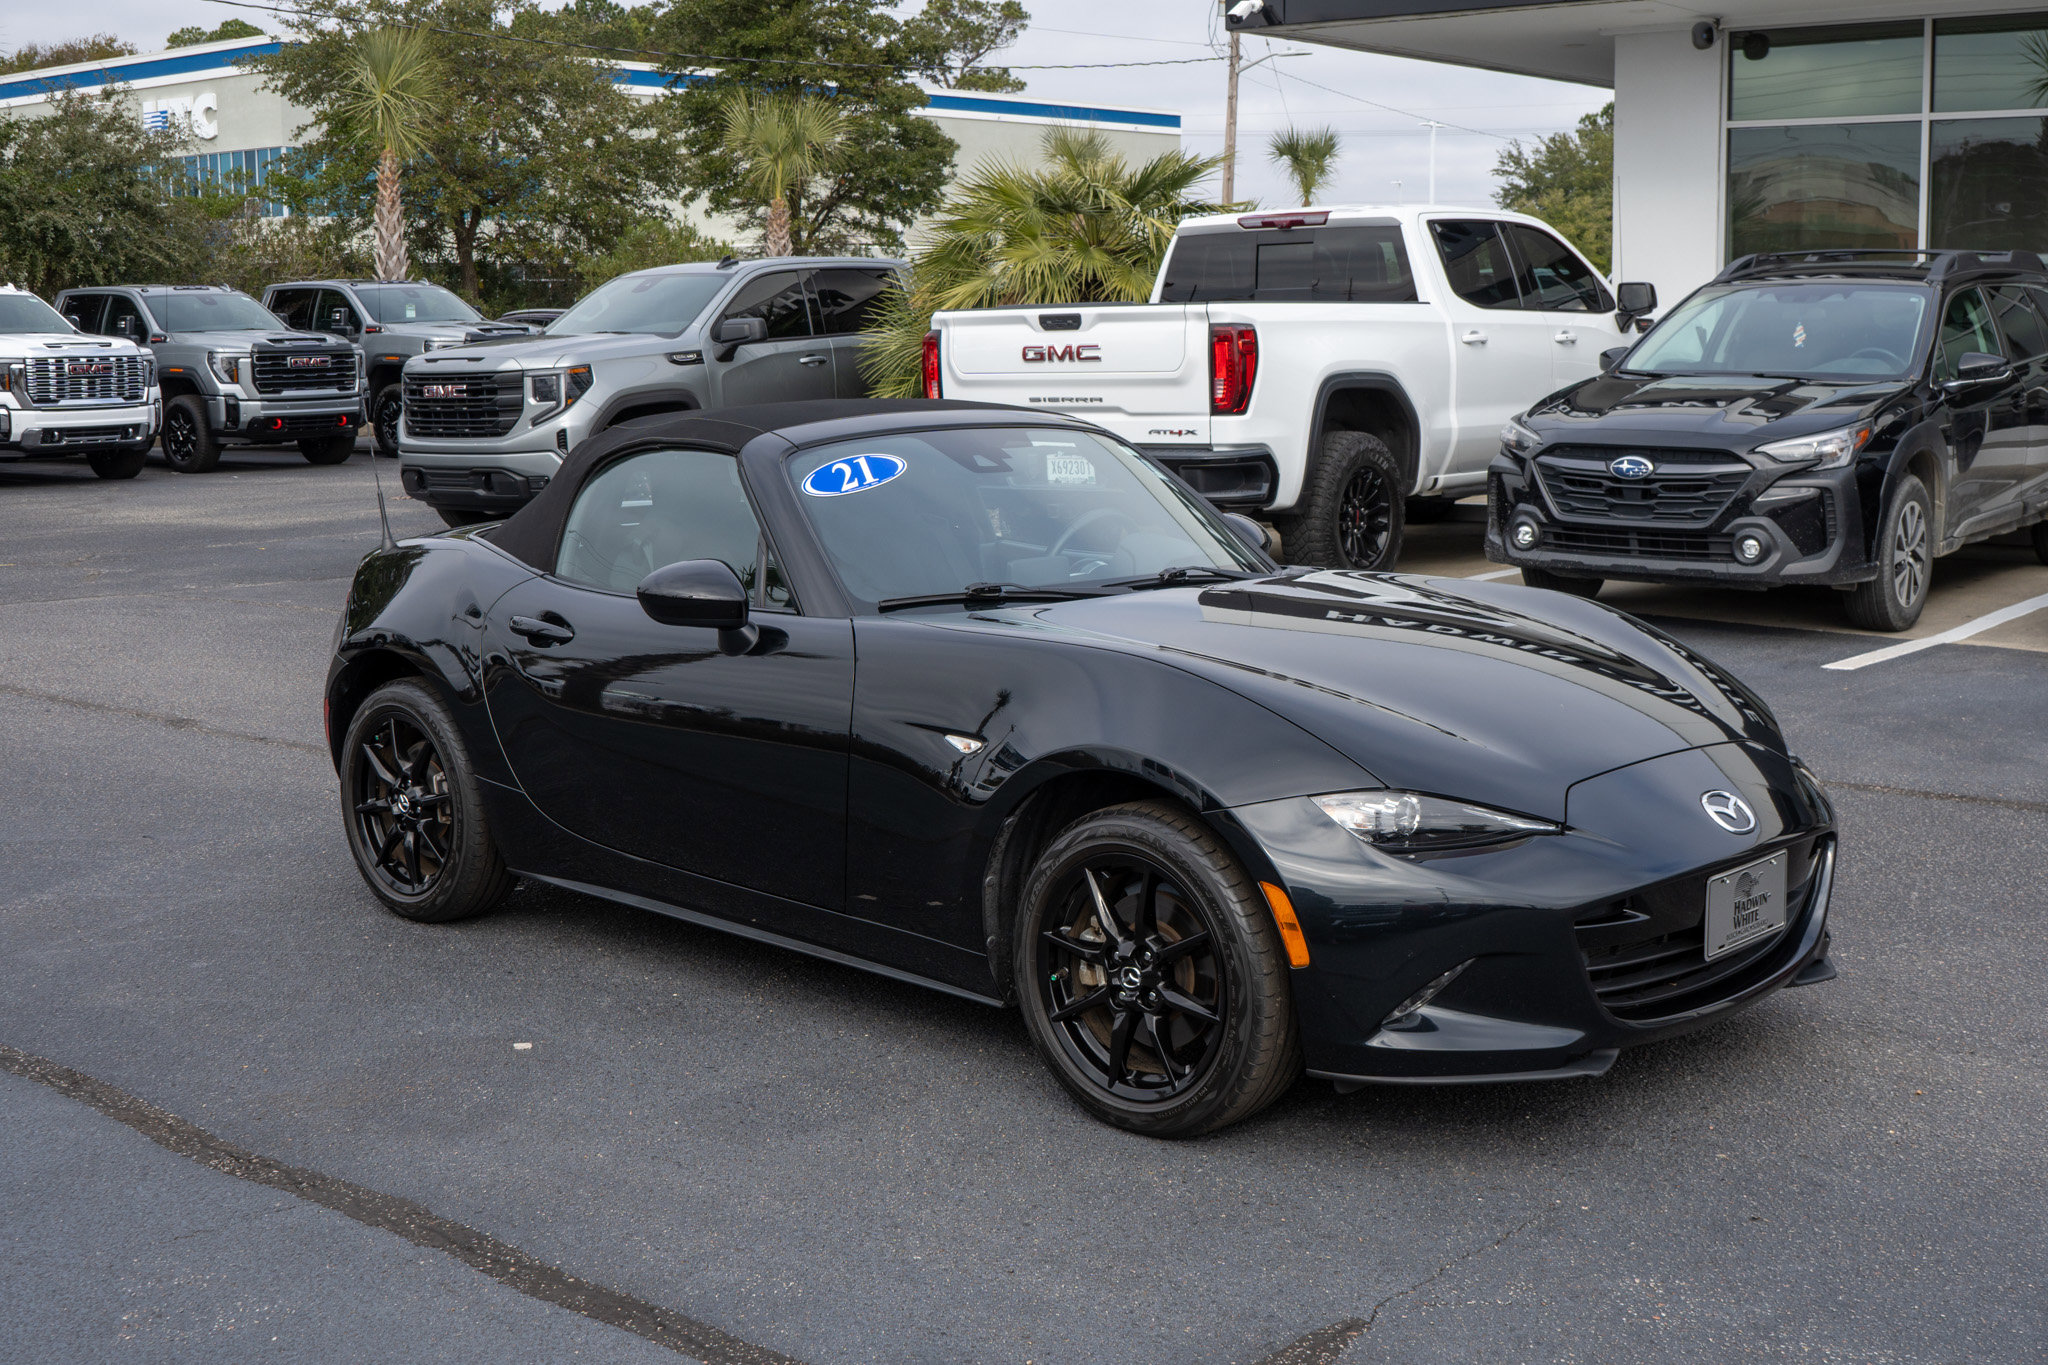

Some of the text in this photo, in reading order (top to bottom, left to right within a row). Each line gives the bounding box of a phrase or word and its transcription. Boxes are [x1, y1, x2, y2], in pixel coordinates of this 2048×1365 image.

[1022, 344, 1102, 363] GMC
[69, 364, 114, 375] GMC
[291, 357, 329, 367] GMC
[423, 384, 467, 398] GMC
[831, 456, 879, 492] 21
[1733, 909, 1759, 929] WHITE
